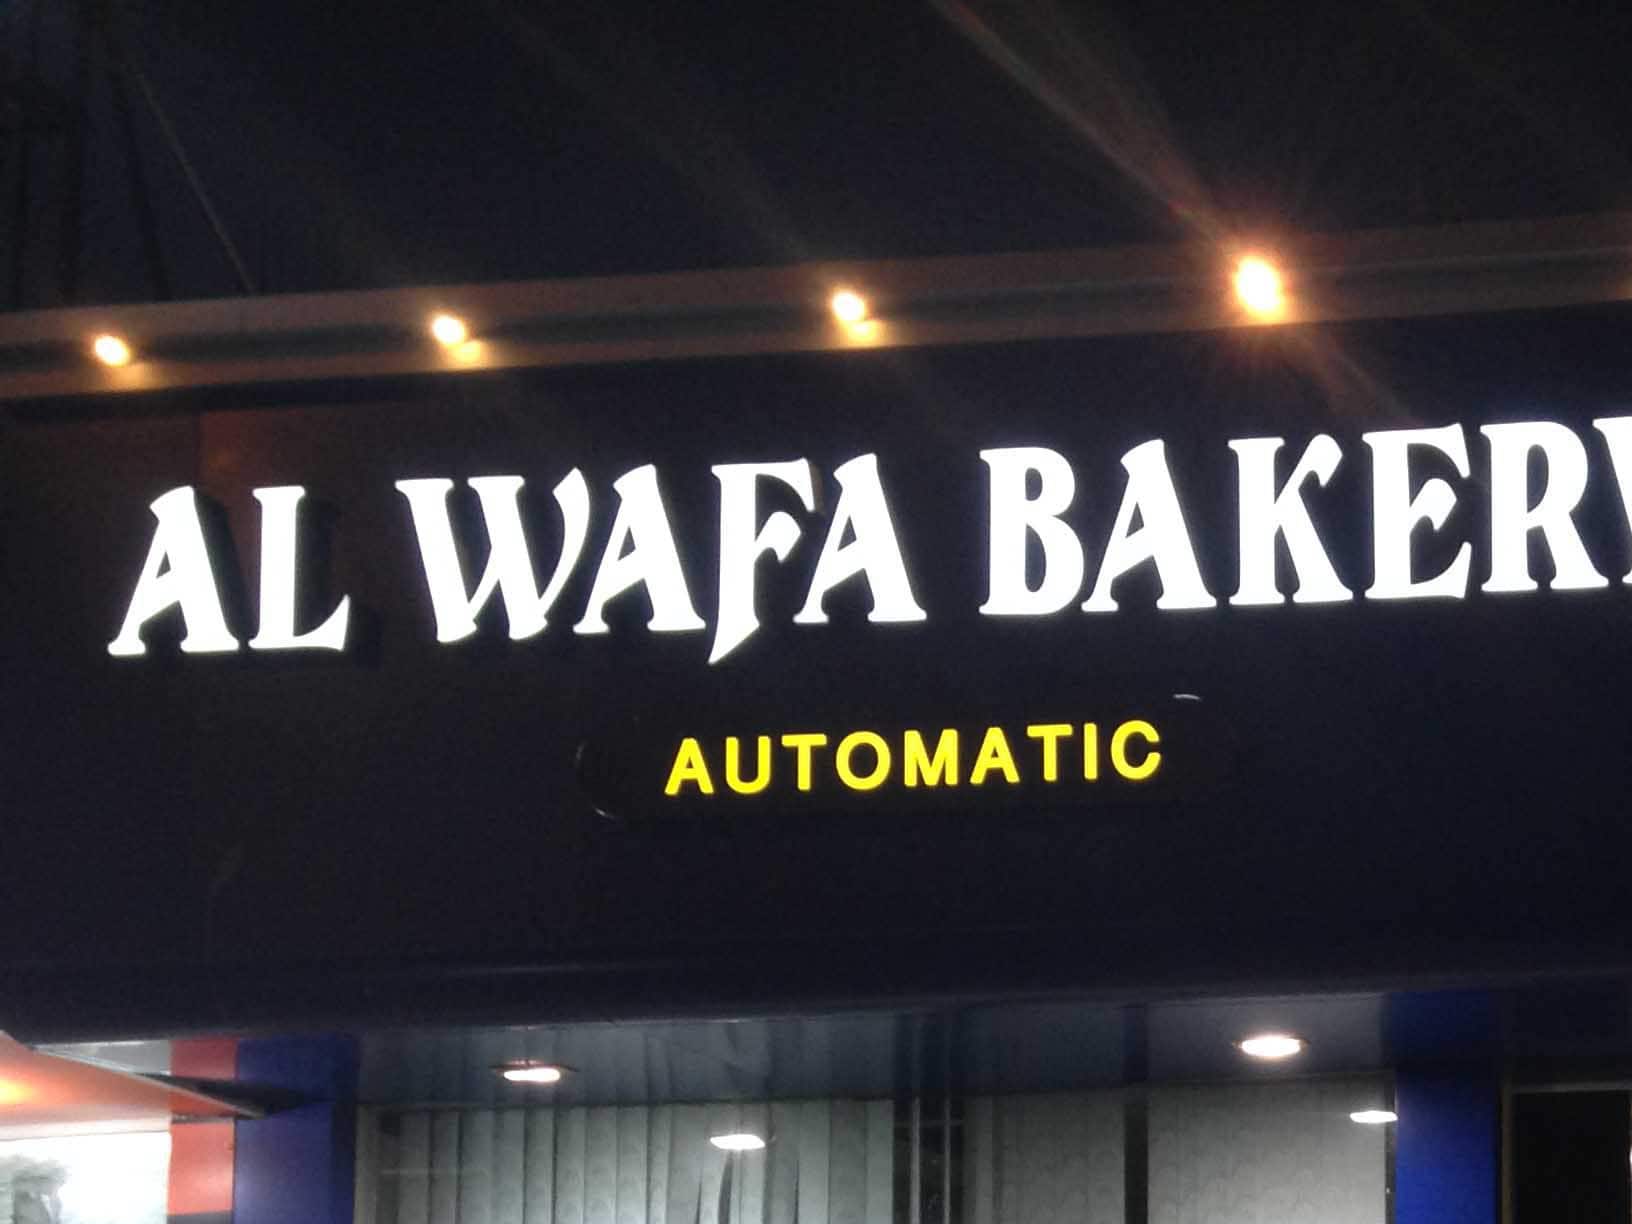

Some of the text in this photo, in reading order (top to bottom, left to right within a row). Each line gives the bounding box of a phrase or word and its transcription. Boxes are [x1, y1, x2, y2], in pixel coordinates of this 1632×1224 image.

[107, 485, 350, 656] AL
[394, 452, 928, 668] WAFA
[664, 719, 1162, 796] AUTOMATIC
